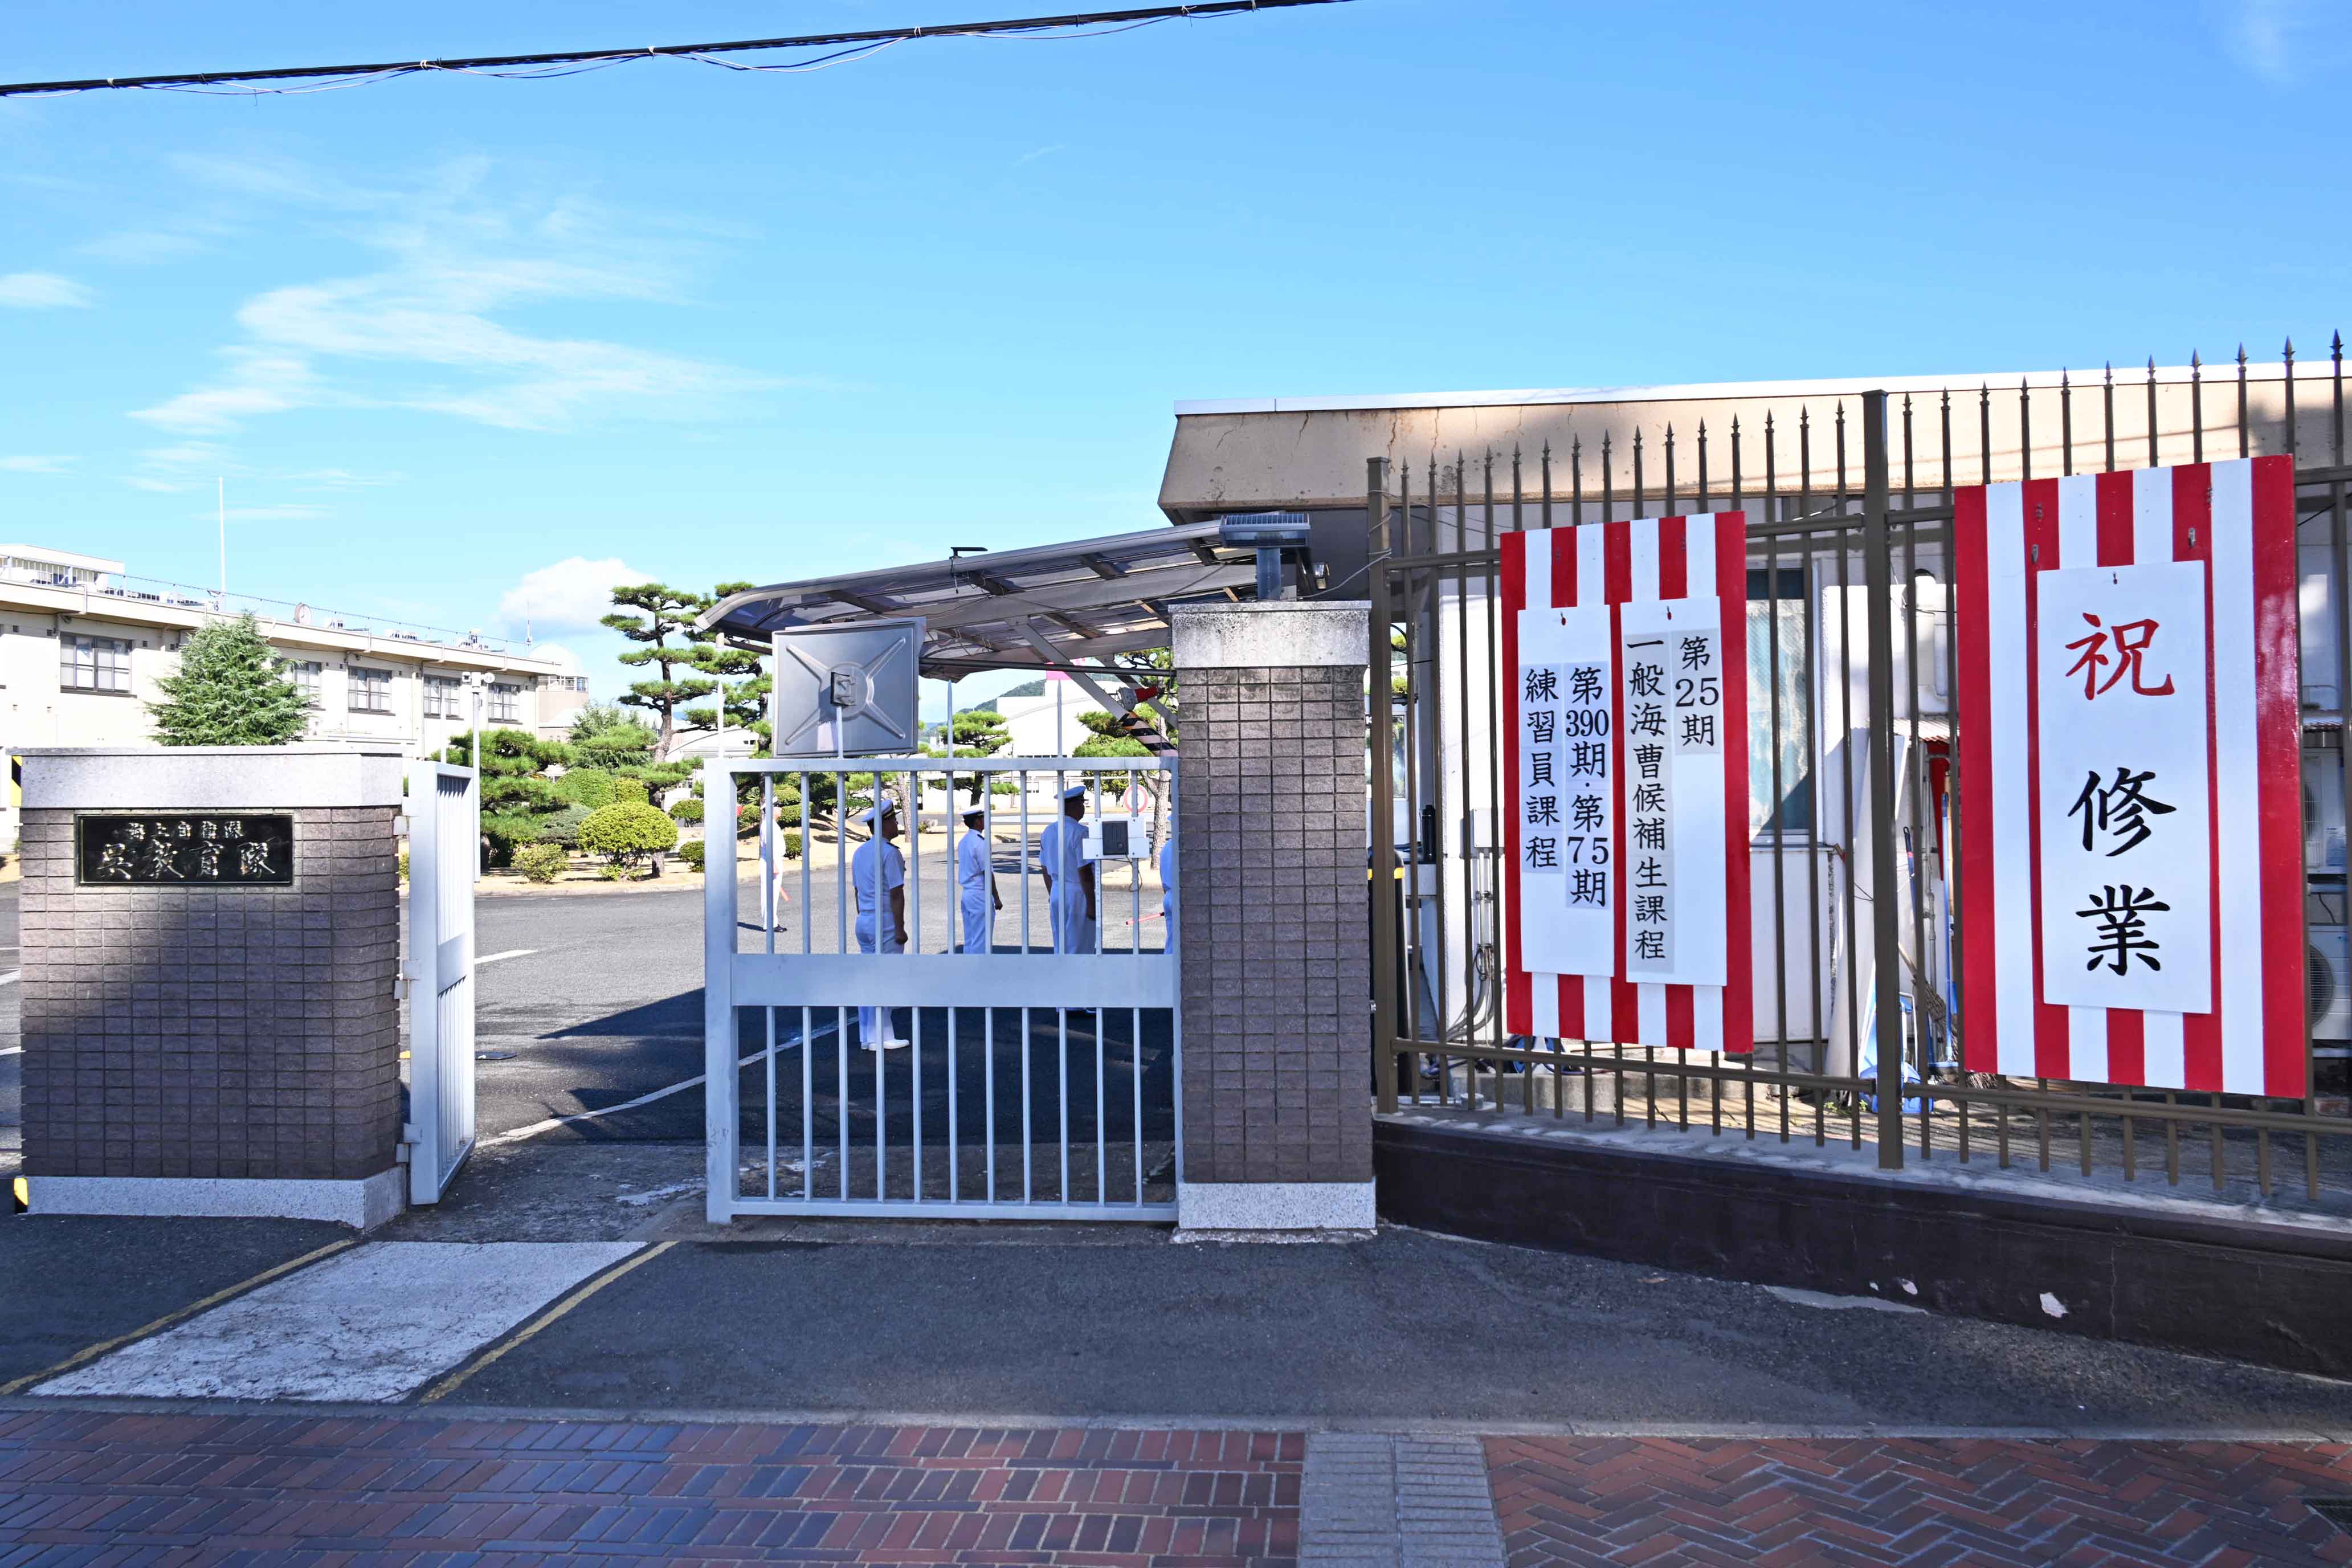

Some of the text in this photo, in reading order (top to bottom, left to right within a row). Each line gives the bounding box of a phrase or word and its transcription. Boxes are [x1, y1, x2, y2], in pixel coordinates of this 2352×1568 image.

[1525, 668, 1561, 868] 練習員課程
[1566, 667, 1610, 907] 第390期・第75期
[1675, 636, 1720, 747] 第25期
[96, 840, 277, 880] 呉教育隊
[126, 820, 244, 842] 海上自衛隊
[1627, 639, 1668, 961] 一般海曹候補生課程
[2066, 613, 2177, 976] 祝 修業
